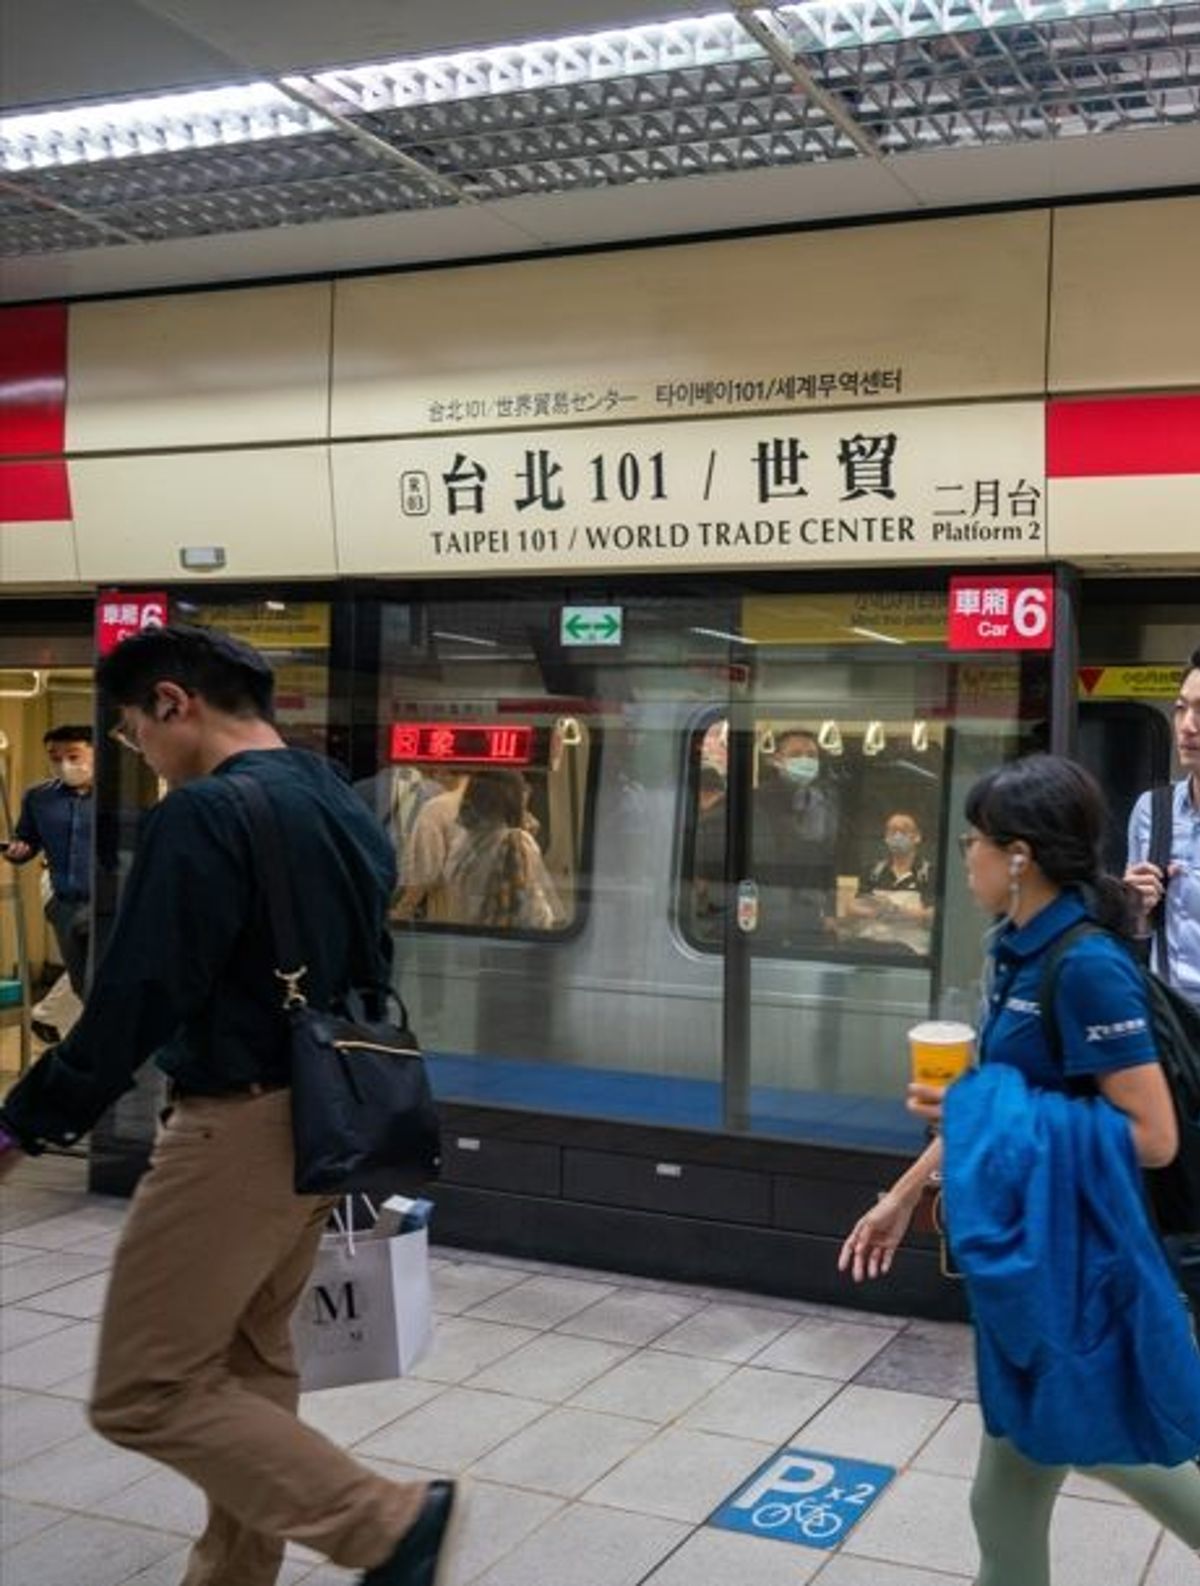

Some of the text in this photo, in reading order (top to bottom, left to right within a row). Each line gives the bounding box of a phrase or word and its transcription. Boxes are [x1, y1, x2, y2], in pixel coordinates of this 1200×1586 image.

[750, 433, 898, 503] 世貿
[932, 479, 1041, 518] 二月台
[430, 530, 509, 555] TAIPEI
[519, 529, 558, 551] 101
[586, 522, 690, 549] WORLD
[697, 521, 791, 547] TRADE
[799, 516, 915, 543] CENTER
[931, 520, 1041, 541] Platform 2
[955, 588, 1009, 616] 車廂
[1013, 587, 1047, 637] 6
[977, 621, 1009, 637] Car
[313, 1280, 360, 1325] M
[730, 1455, 836, 1509] P
